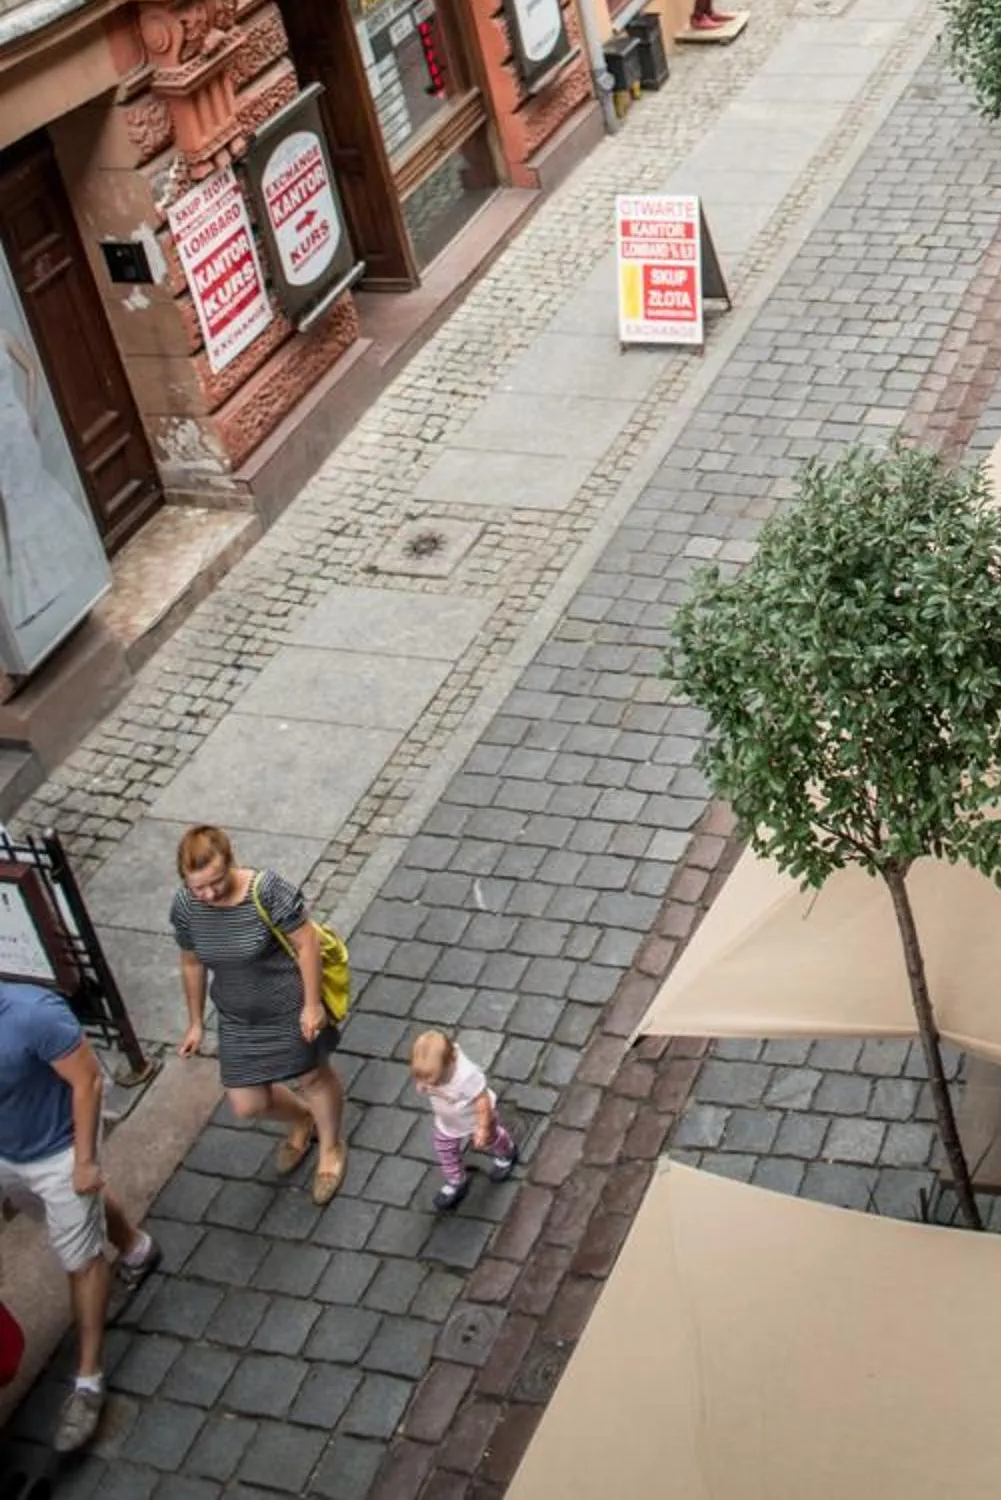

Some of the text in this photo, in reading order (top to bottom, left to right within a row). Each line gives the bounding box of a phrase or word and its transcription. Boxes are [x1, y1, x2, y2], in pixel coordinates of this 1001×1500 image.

[265, 144, 321, 199] EXCHANGE
[271, 164, 326, 223] KANTOR
[183, 203, 241, 258] LOMBARD
[619, 200, 696, 218] OTWARTE
[629, 224, 685, 238] KANTOR
[194, 233, 250, 290] KANTOR
[289, 220, 330, 266] KURS
[202, 261, 257, 317] KURS
